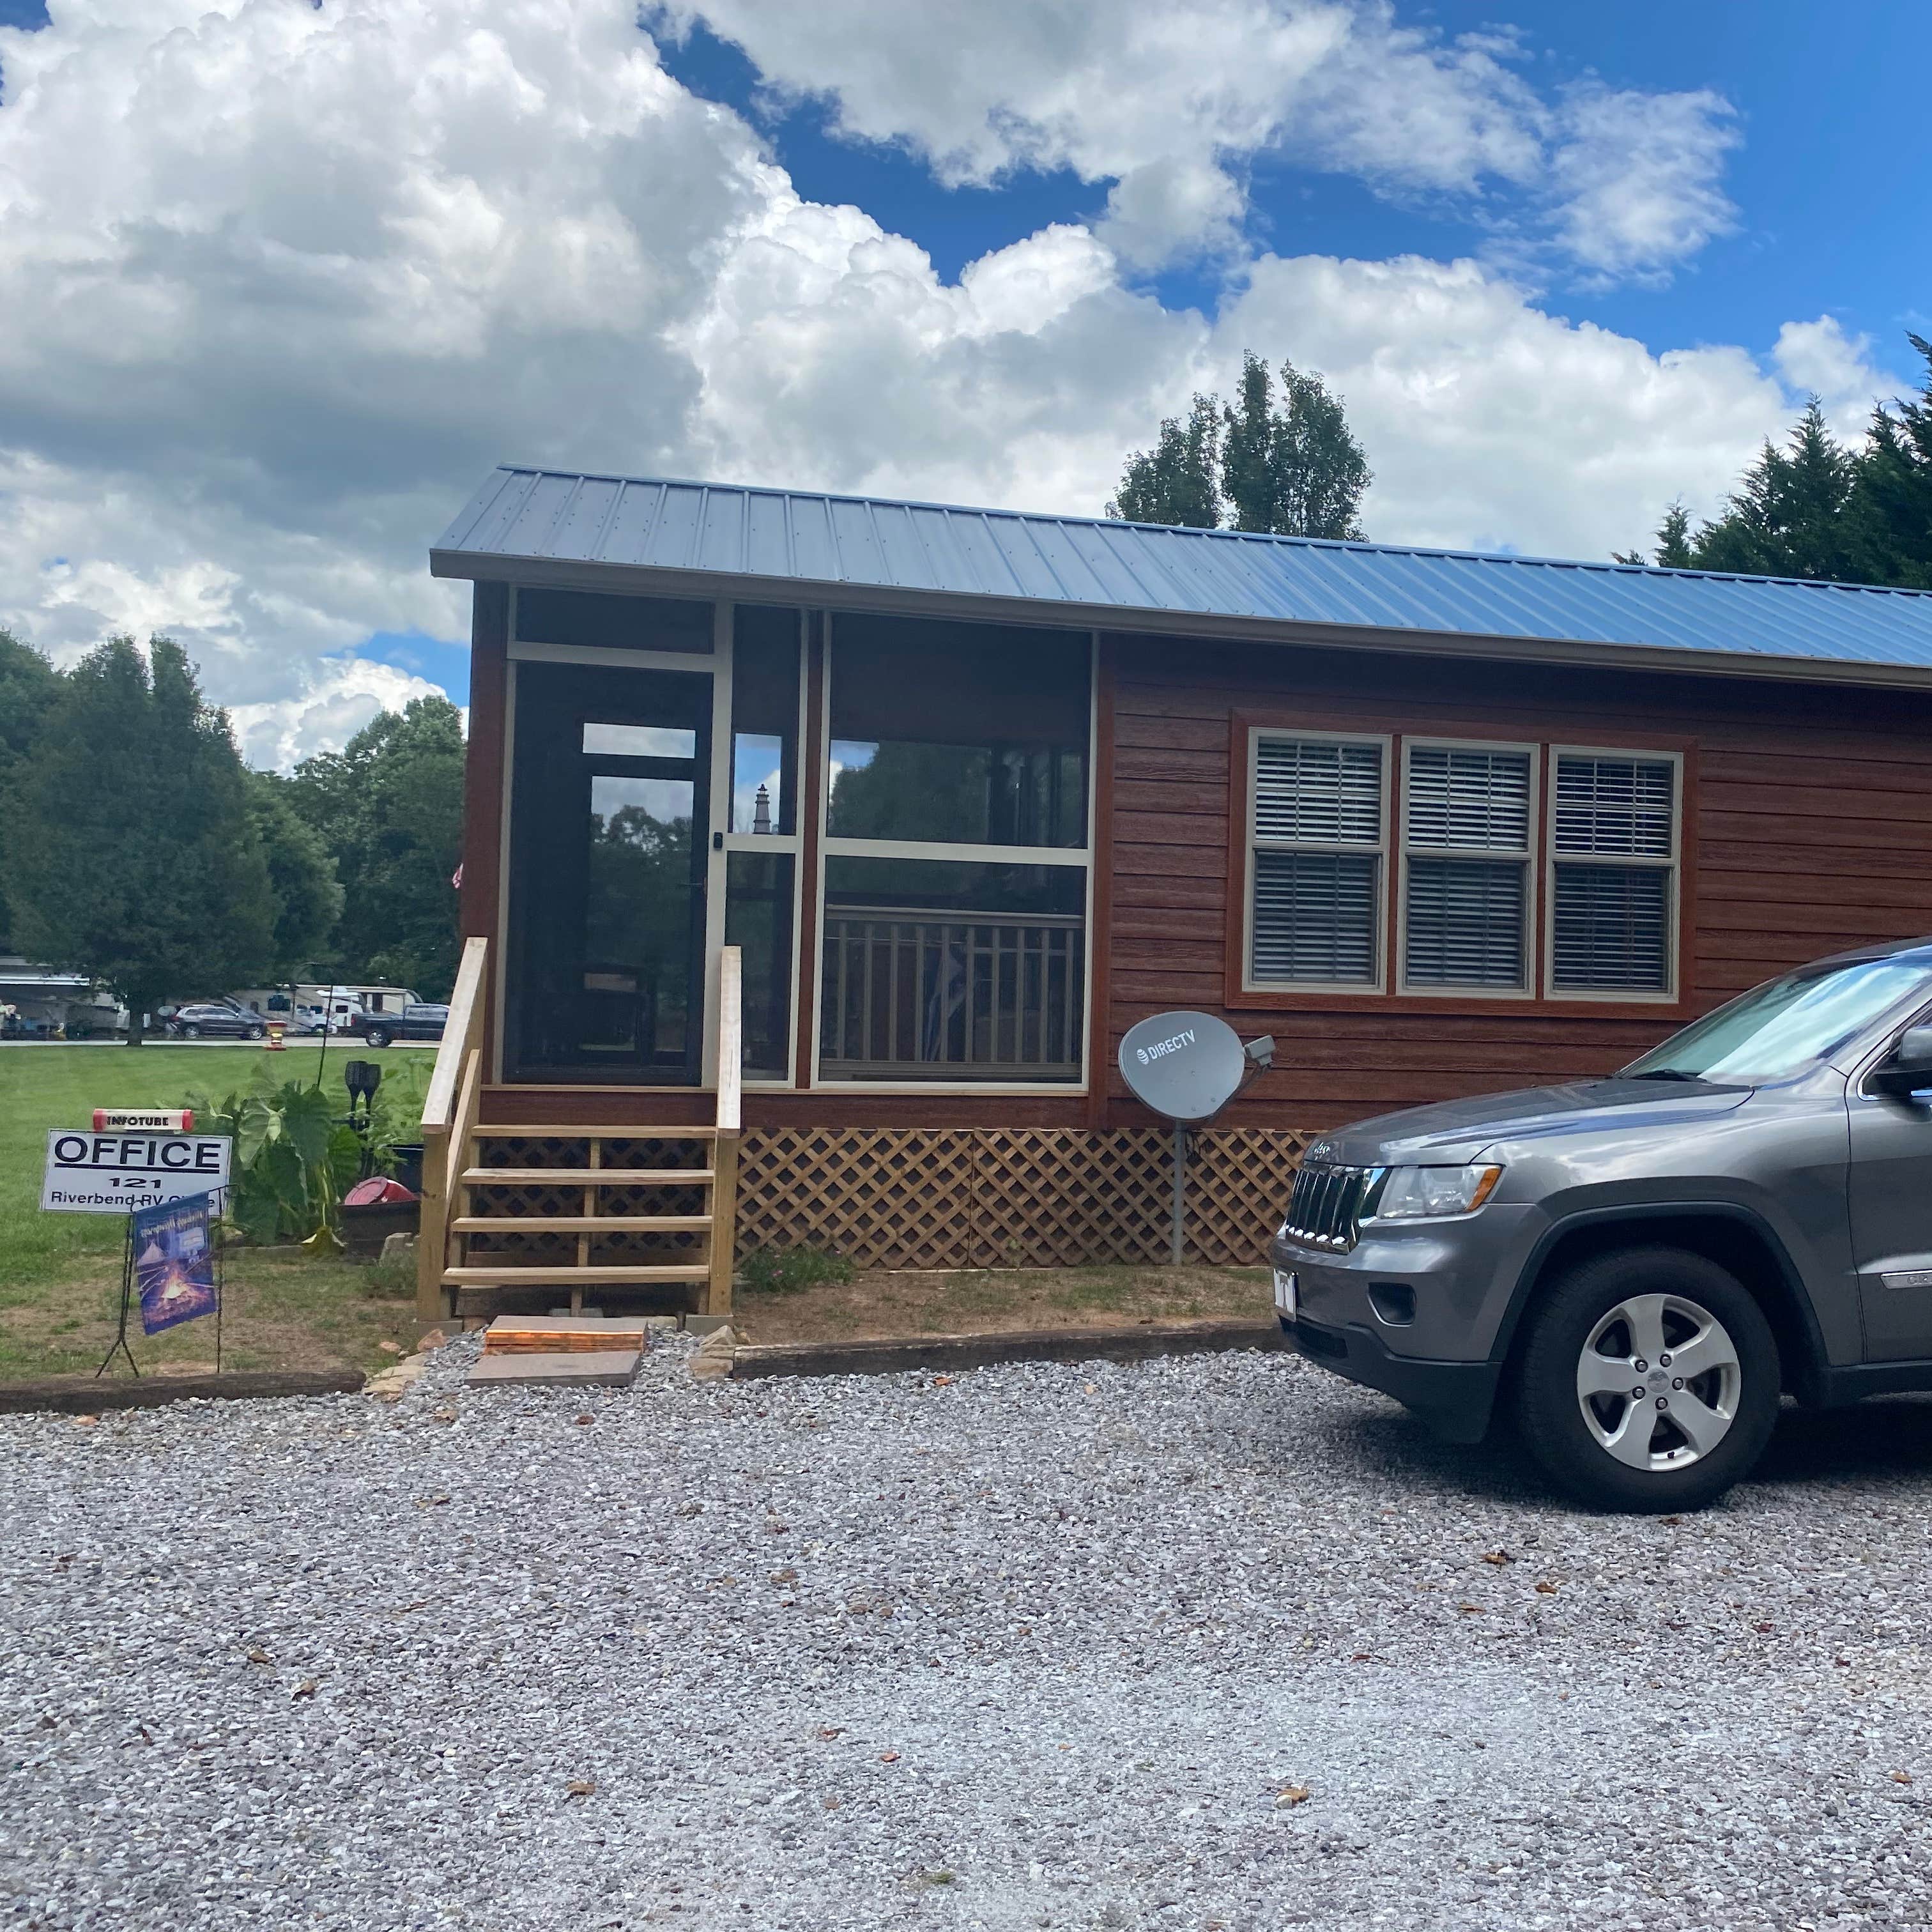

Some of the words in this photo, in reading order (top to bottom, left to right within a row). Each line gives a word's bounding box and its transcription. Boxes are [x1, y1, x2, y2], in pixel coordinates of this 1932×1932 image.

[1147, 1029, 1196, 1060] DIRECTV
[54, 1137, 221, 1168] OFFICE
[109, 1177, 162, 1188] 121
[51, 1191, 135, 1205] Riverbend
[141, 1194, 164, 1206] RV
